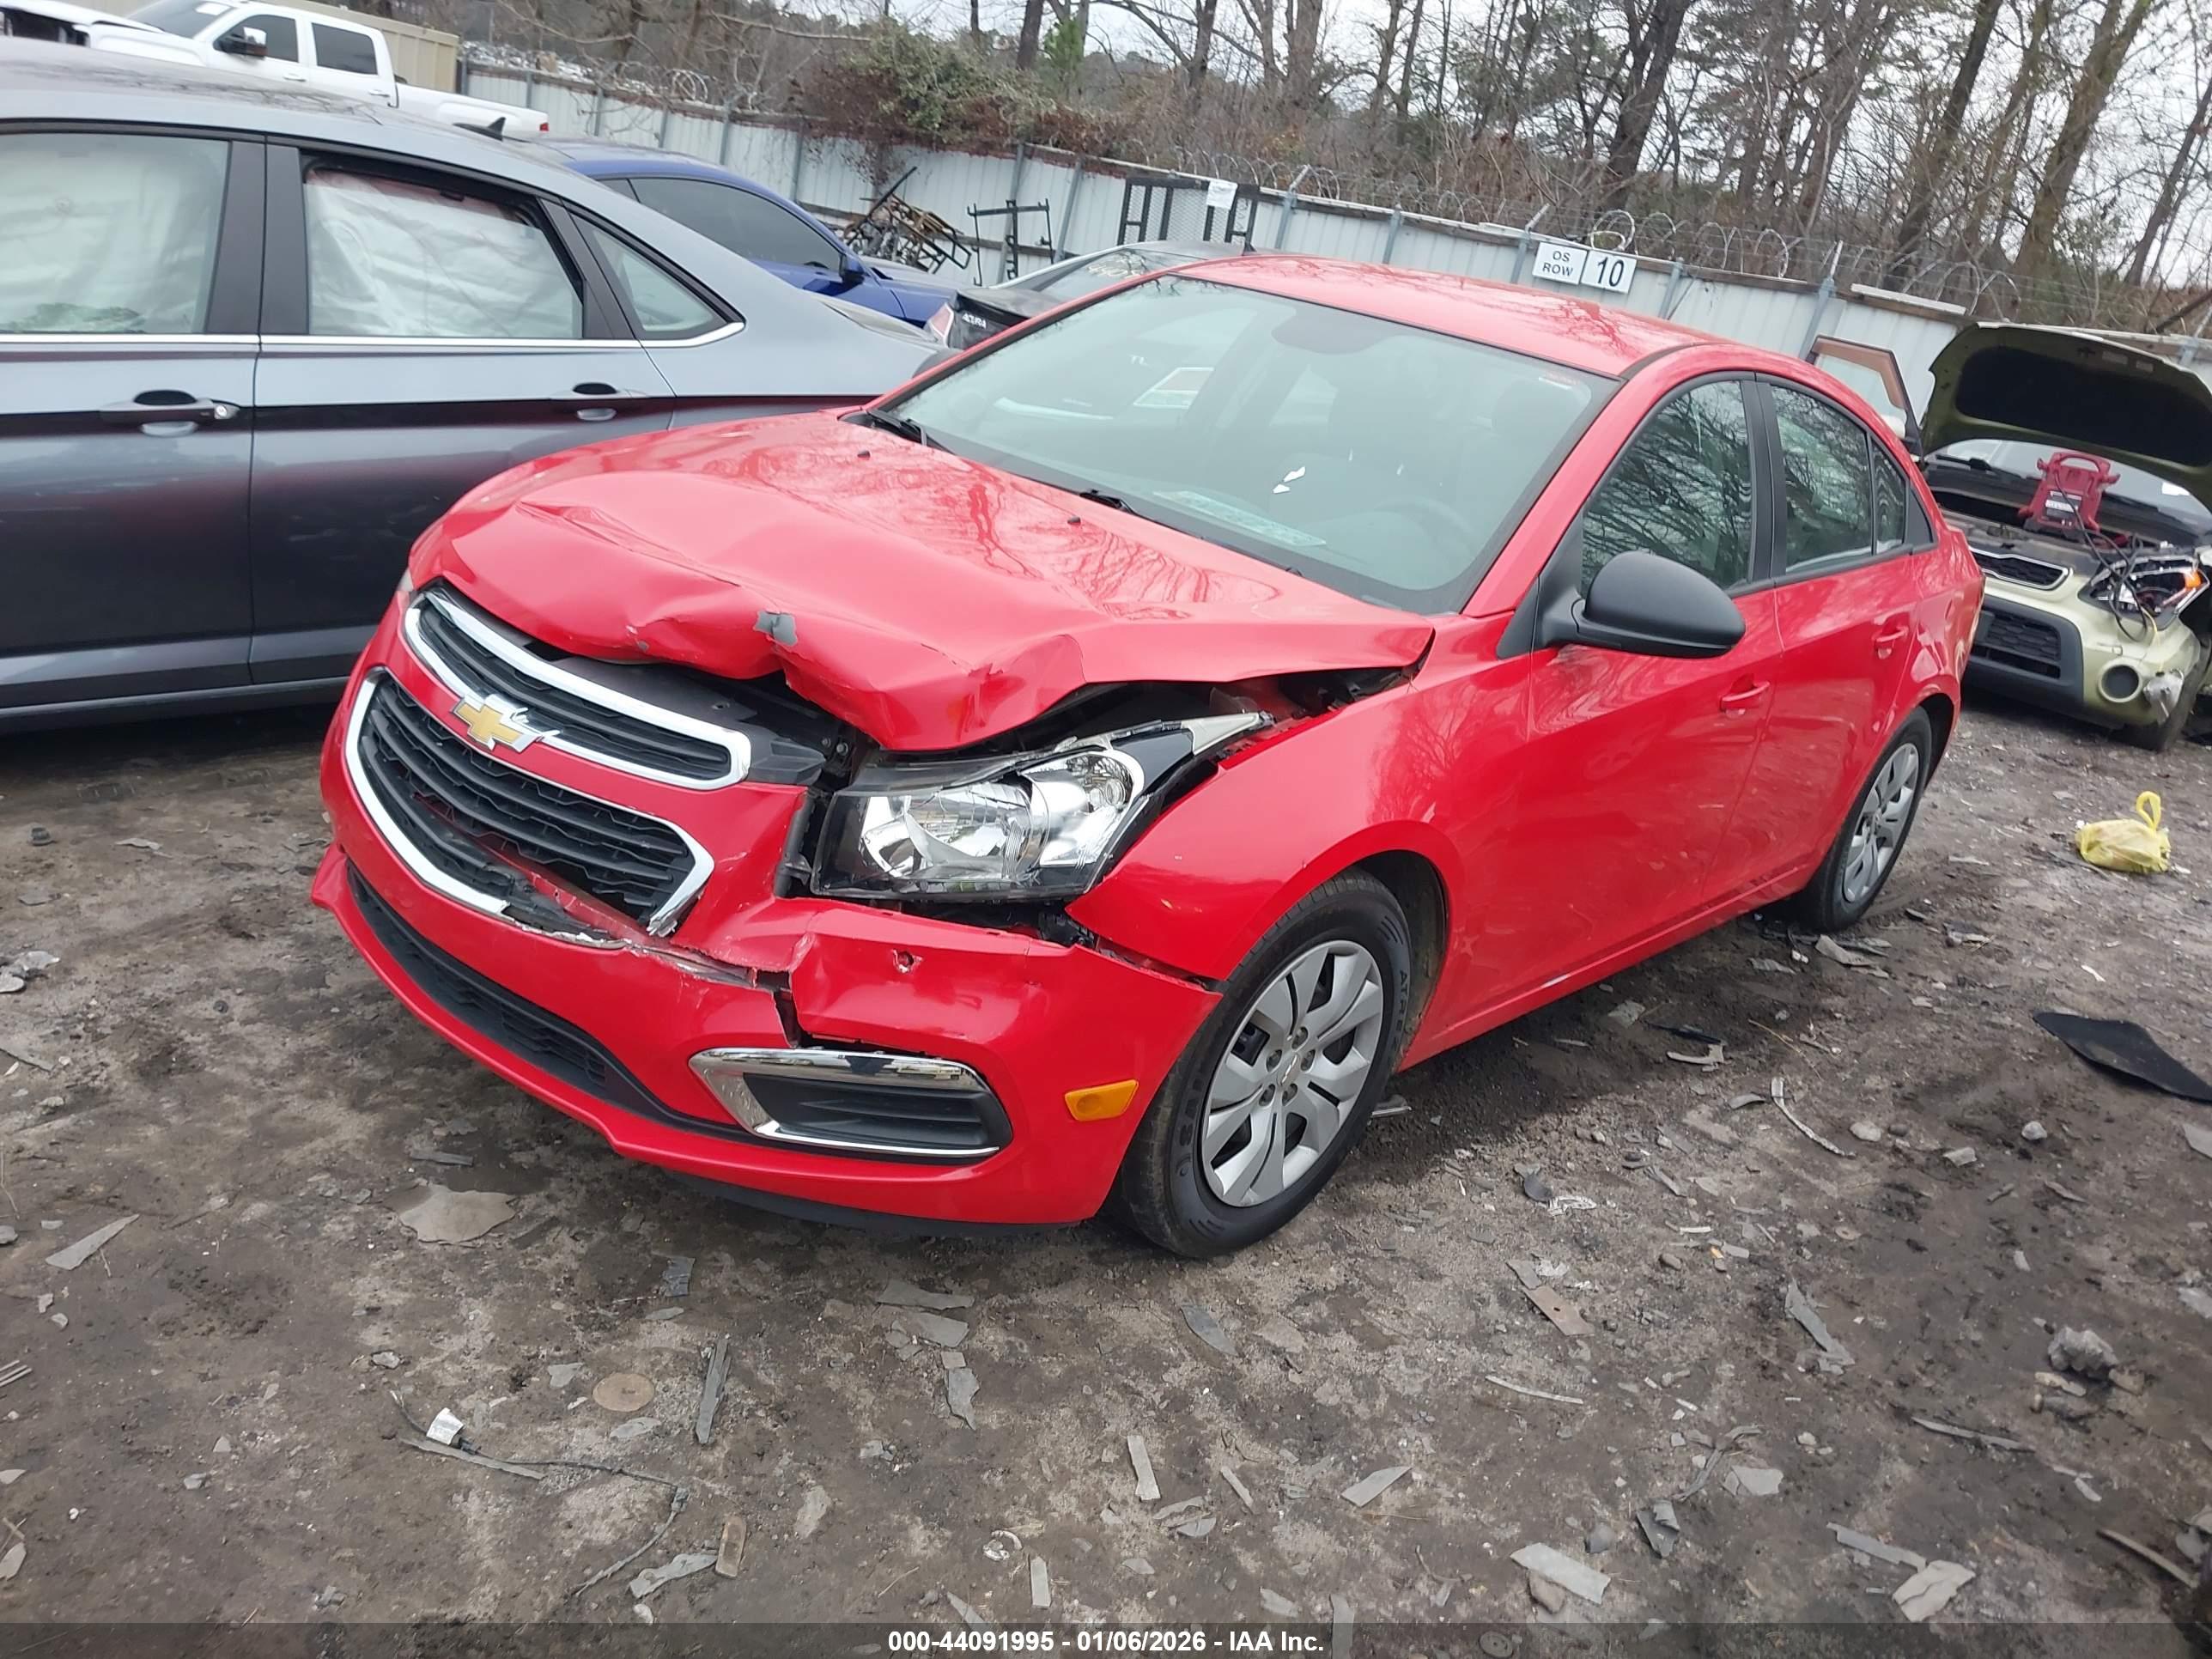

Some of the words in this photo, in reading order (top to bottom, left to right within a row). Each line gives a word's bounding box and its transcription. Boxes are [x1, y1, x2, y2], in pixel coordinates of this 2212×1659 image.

[1553, 250, 1571, 263] OS
[1542, 262, 1574, 277] ROW
[1597, 256, 1625, 288] 10
[962, 313, 987, 330] ACURA
